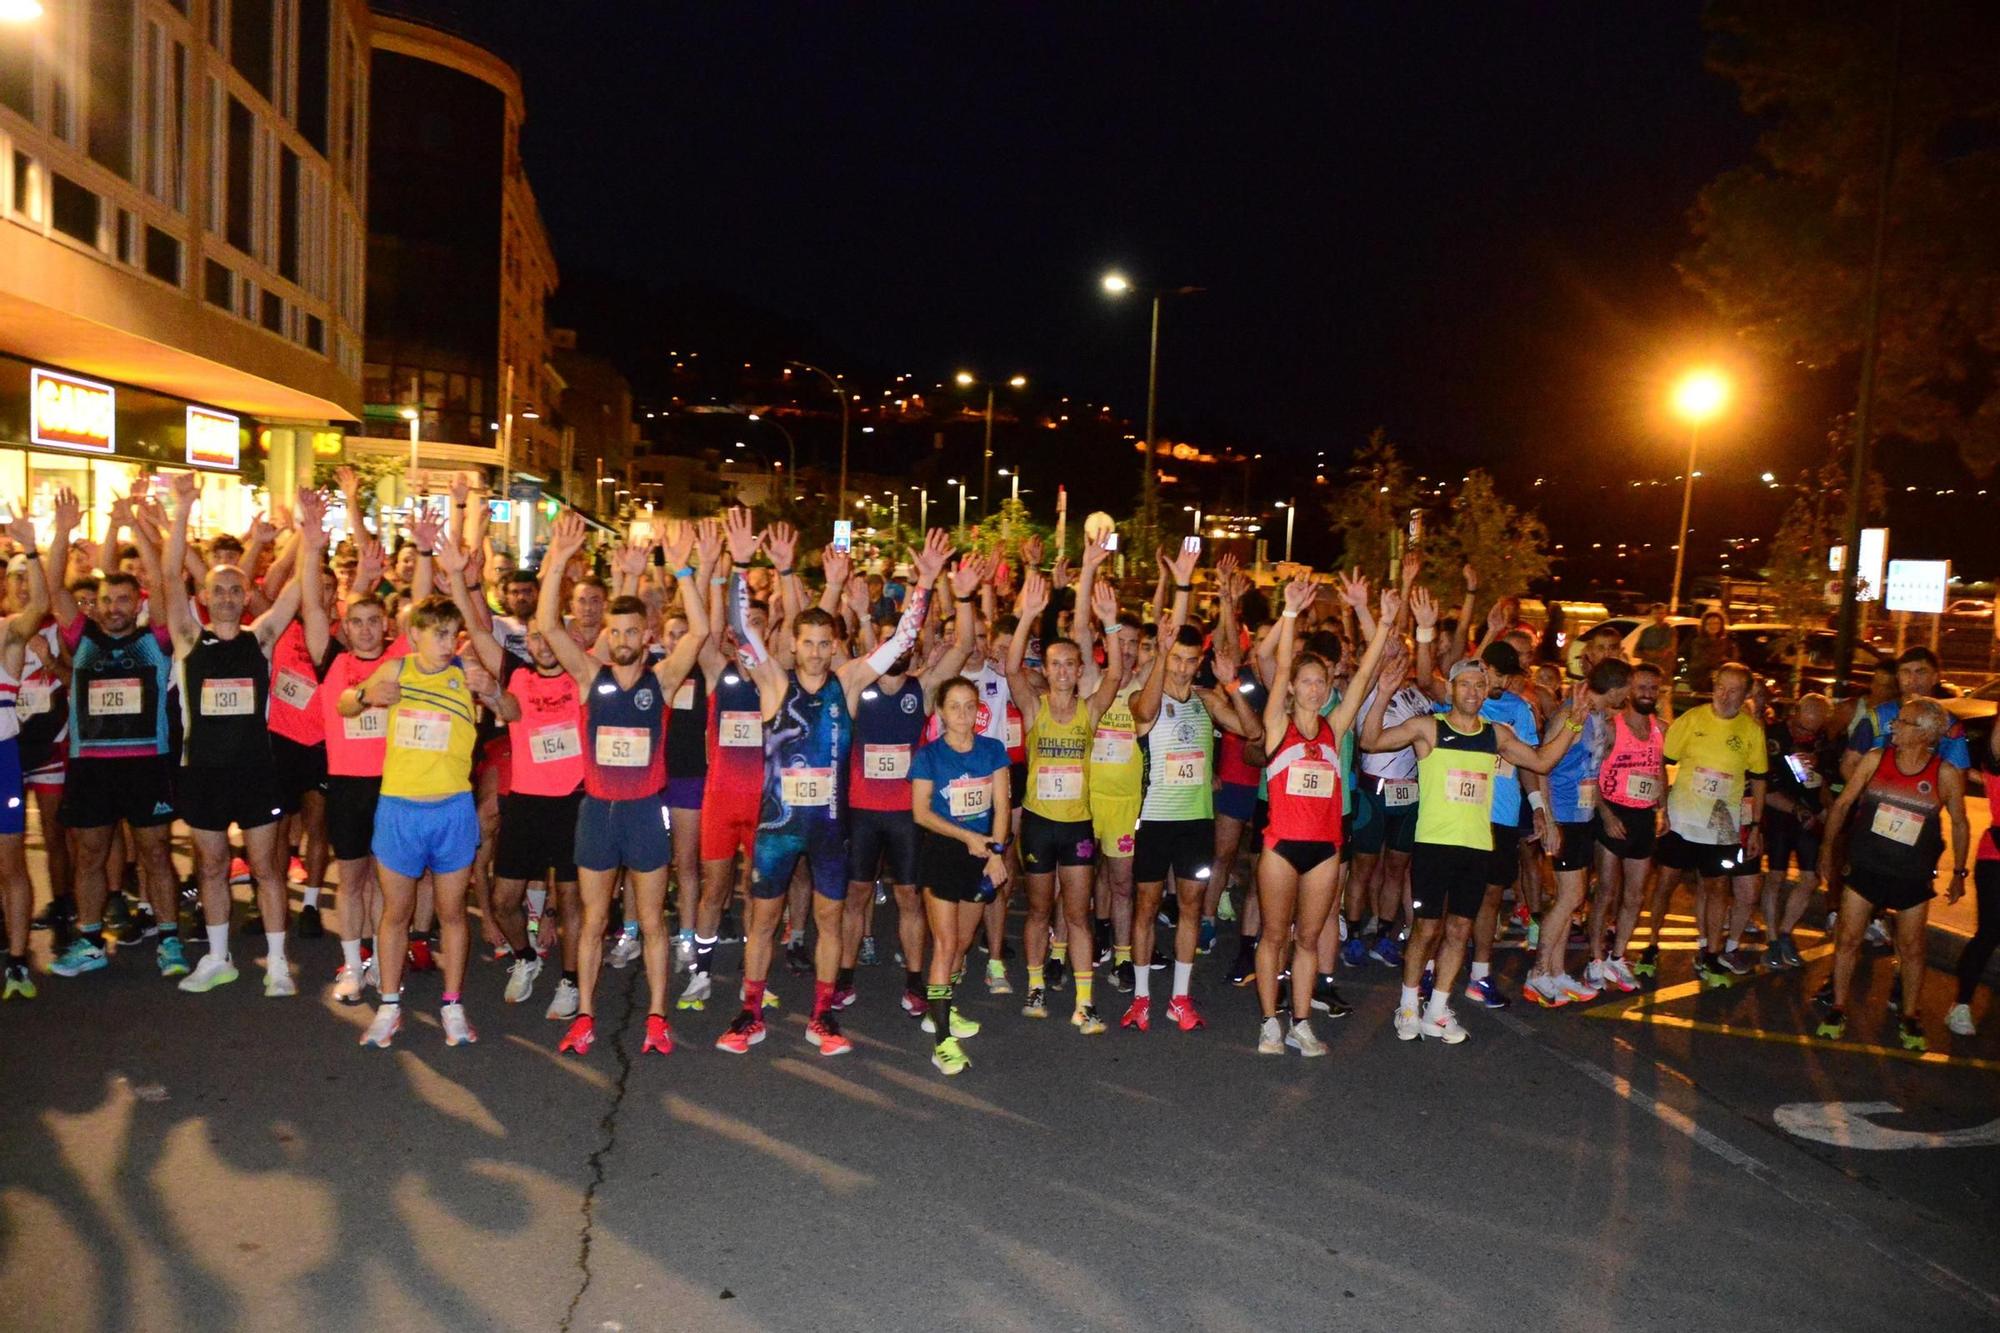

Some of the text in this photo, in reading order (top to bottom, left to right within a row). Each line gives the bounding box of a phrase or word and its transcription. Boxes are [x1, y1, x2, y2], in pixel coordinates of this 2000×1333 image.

[281, 682, 298, 698] 45
[102, 691, 124, 707] 126
[214, 692, 237, 708] 130
[359, 715, 377, 731] 101
[734, 724, 750, 739] 52
[542, 737, 565, 754] 154
[611, 740, 630, 758] 53
[878, 756, 895, 772] 55
[1177, 763, 1194, 779] 43
[794, 781, 817, 798] 136
[1302, 773, 1319, 790] 56
[1639, 781, 1653, 795] 97
[1702, 778, 1719, 793] 23
[1395, 787, 1409, 800] 80
[1459, 782, 1476, 798] 131
[963, 790, 984, 808] 153
